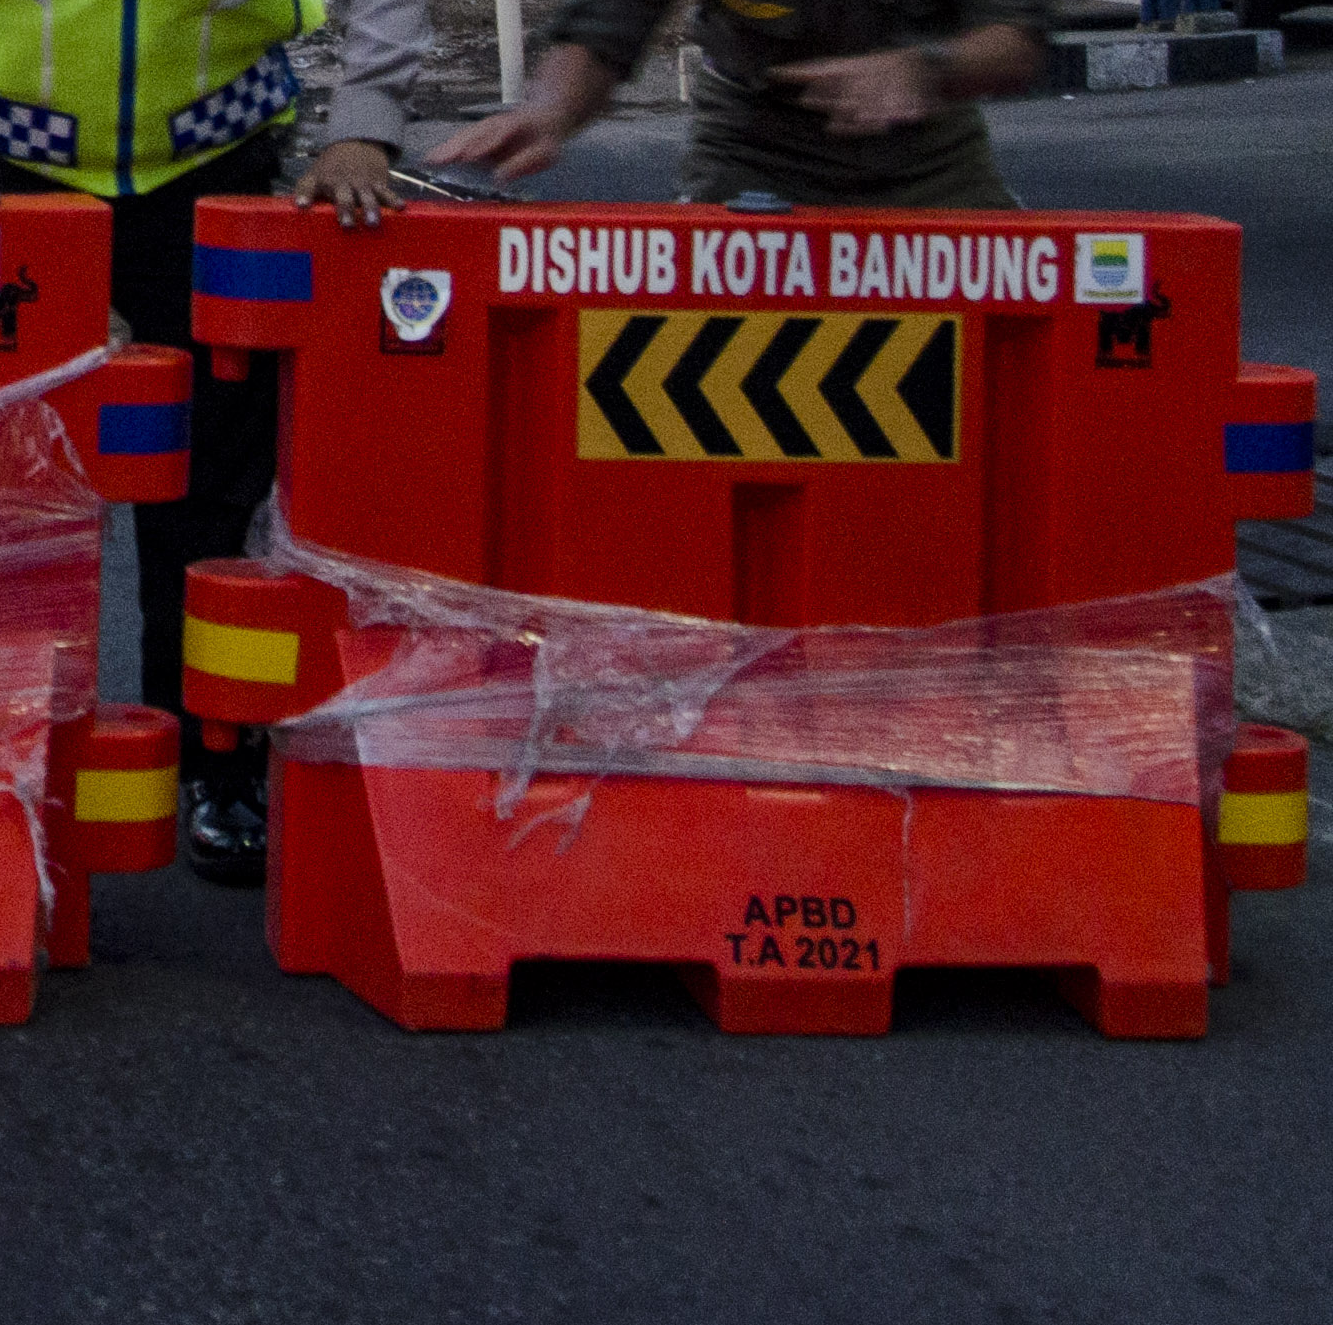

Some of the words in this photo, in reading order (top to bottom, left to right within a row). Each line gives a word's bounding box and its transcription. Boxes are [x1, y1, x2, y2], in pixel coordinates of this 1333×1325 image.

[499, 227, 677, 295] DISHUB
[691, 230, 816, 296] KOTA
[829, 232, 1059, 302] BANDUNG
[744, 895, 857, 930] APBD
[795, 936, 881, 971] 2021
